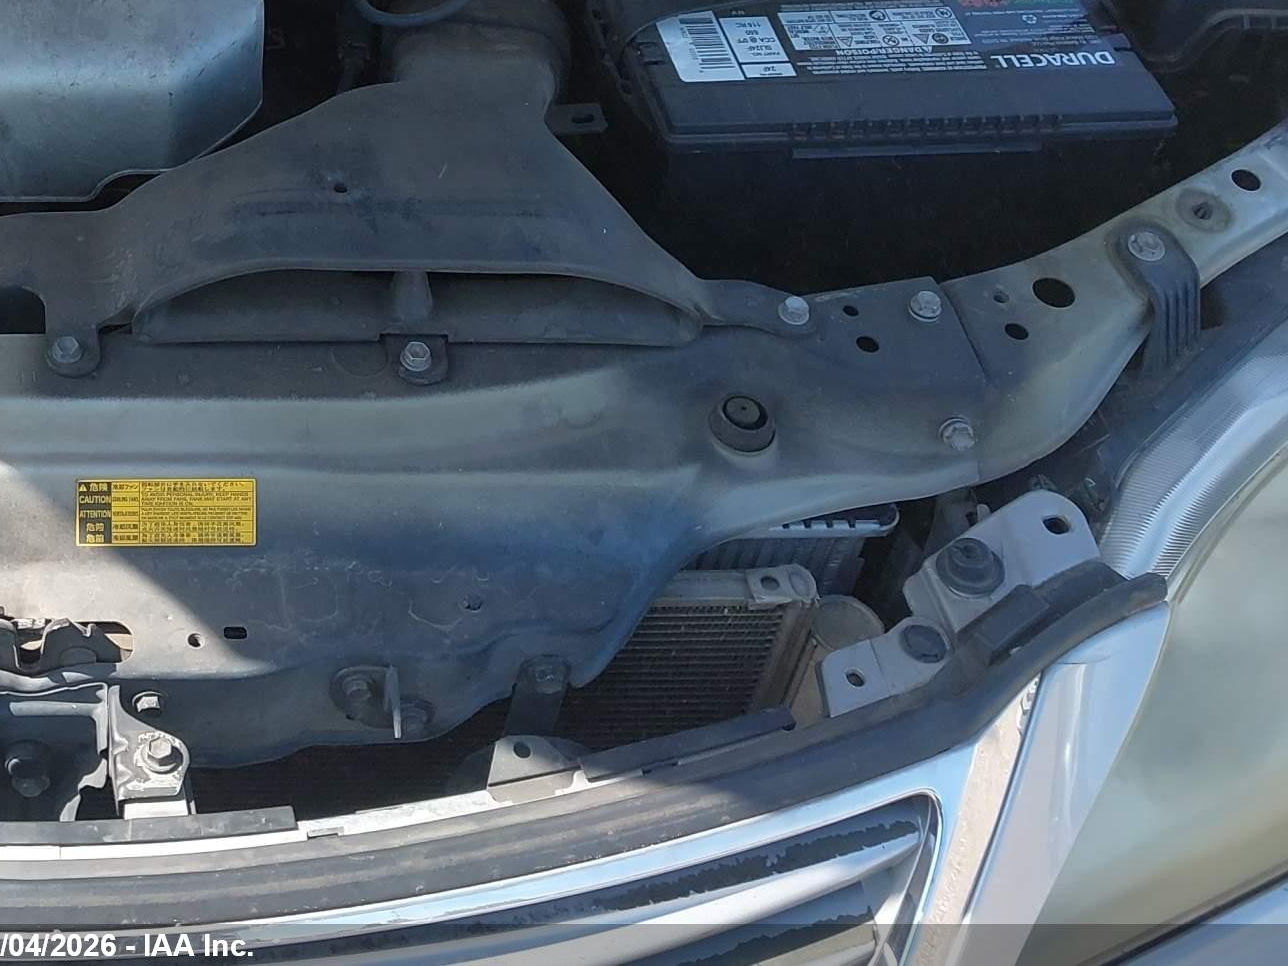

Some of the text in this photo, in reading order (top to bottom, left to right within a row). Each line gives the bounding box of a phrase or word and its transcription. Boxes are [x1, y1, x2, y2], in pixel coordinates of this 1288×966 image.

[836, 45, 921, 56] DANGER/POISON
[991, 50, 1115, 69] DURACELL
[79, 495, 111, 504] CAUTION
[79, 509, 112, 518] ATTENTION
